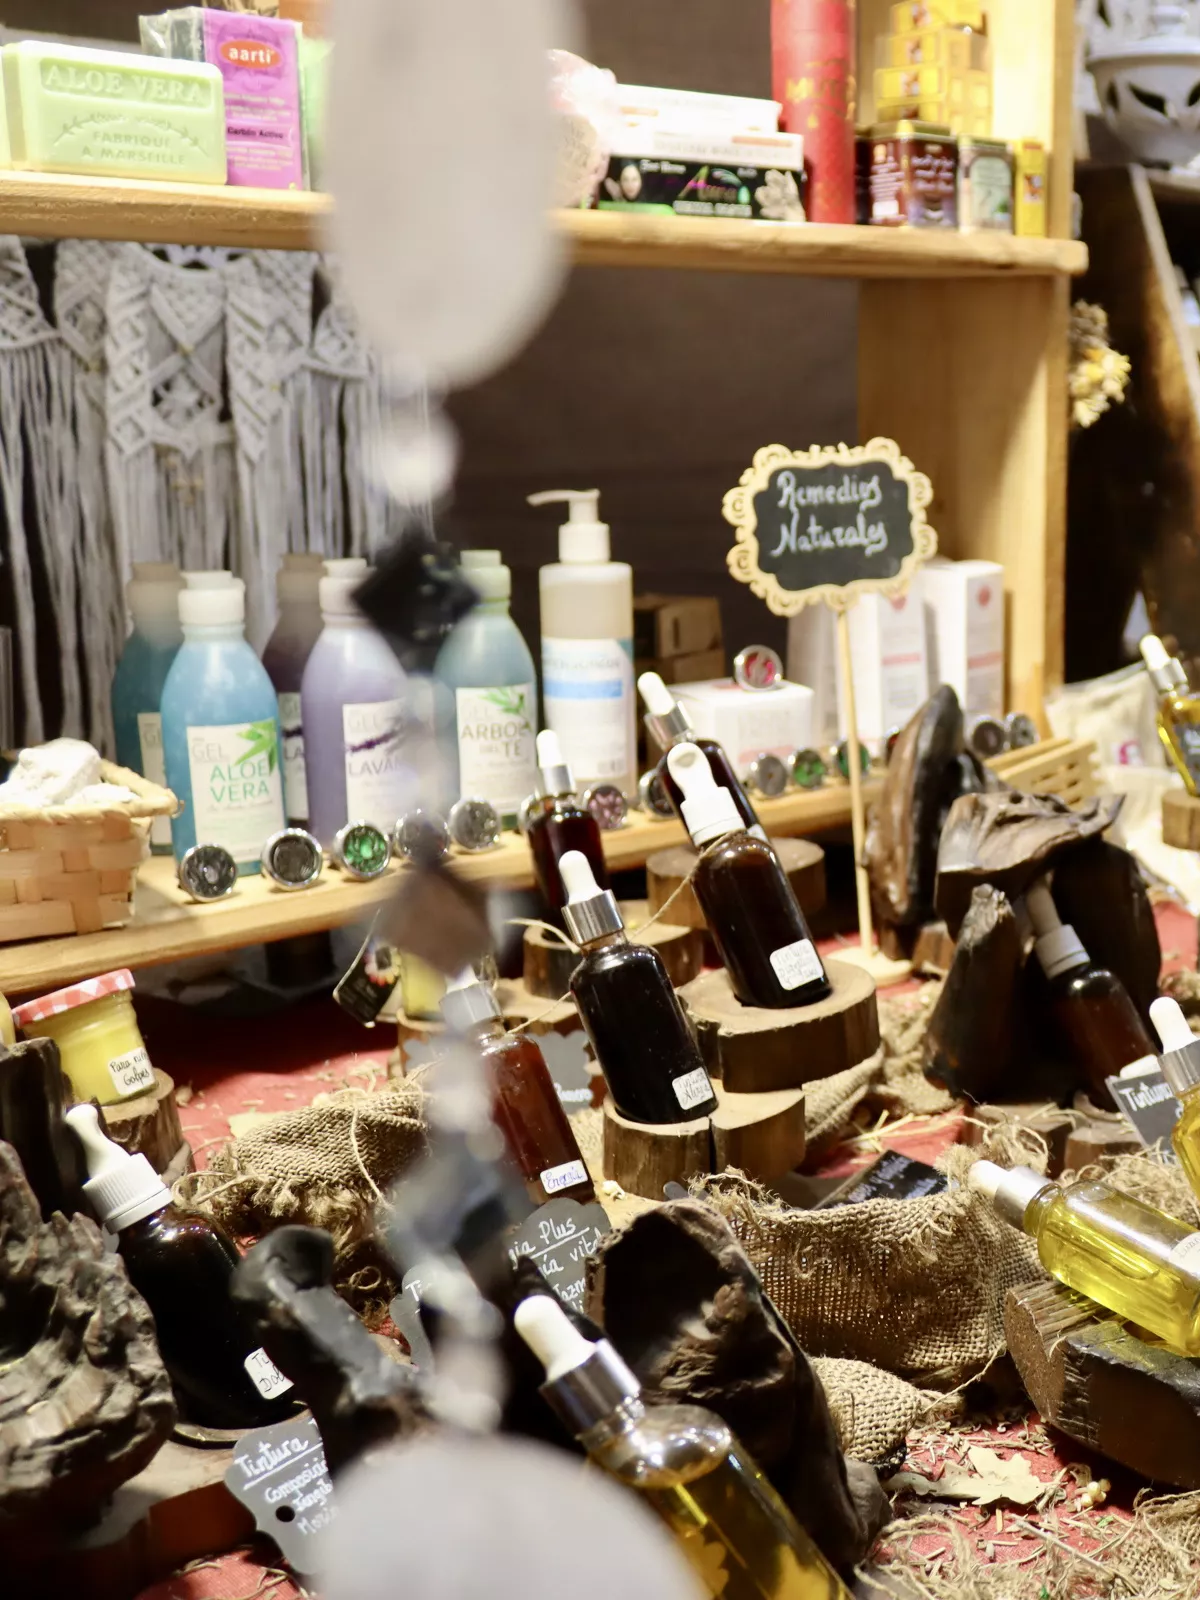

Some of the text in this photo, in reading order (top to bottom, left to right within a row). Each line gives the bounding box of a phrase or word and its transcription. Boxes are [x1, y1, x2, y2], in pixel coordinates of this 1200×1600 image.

[228, 46, 272, 64] aarti
[45, 64, 123, 93] ALOE
[132, 73, 205, 107] VERA
[93, 131, 171, 146] FABRIQUE
[101, 148, 186, 164] MARSEILLE
[777, 470, 882, 511] Remedios
[770, 513, 888, 557] Naturales
[210, 759, 269, 782] ALOE
[209, 781, 270, 803] VERA
[538, 1217, 577, 1245] Plus
[234, 1437, 309, 1478] Tintura
